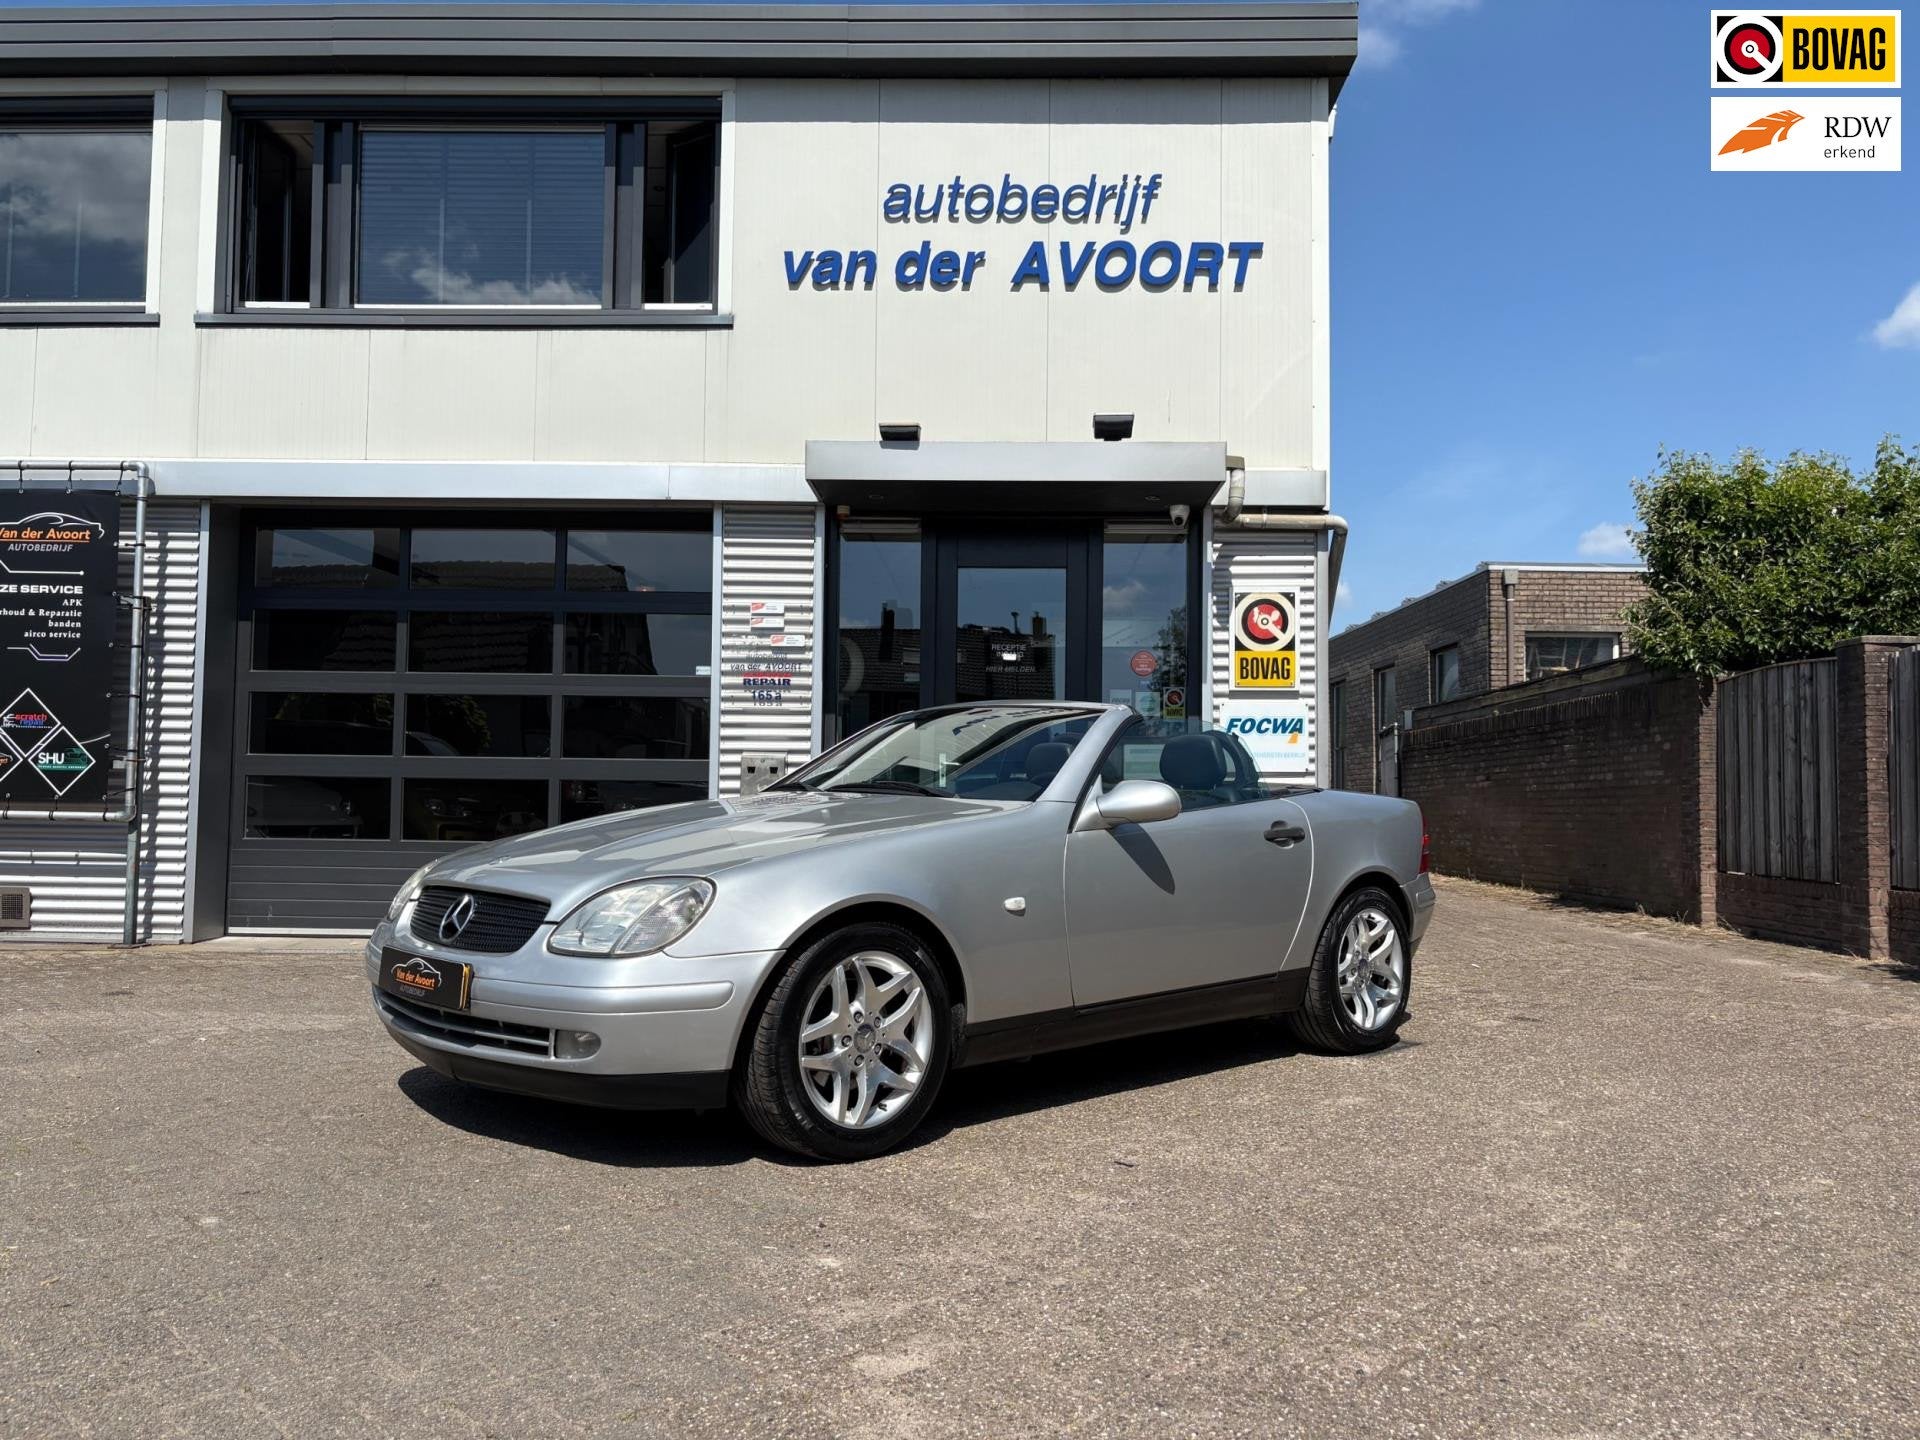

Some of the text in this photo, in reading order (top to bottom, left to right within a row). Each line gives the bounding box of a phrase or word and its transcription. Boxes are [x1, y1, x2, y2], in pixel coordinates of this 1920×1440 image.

[883, 174, 1162, 231] autobedrijf
[784, 240, 1263, 289] van der AVOORT
[21, 527, 43, 539] der
[46, 528, 91, 540] Avoort
[8, 543, 73, 552] AUTOBEDRIJF
[20, 584, 83, 594] SERVICE
[28, 608, 36, 616] &
[39, 608, 82, 618] Reparatie
[48, 620, 81, 628] banden
[24, 630, 81, 638] airco service
[1239, 656, 1291, 680] BOVAG
[743, 678, 792, 686] REPAIR
[752, 690, 773, 700] 165
[1226, 718, 1304, 734] FOCWA
[38, 752, 65, 764] SHU
[396, 968, 435, 988] Van der Avoort
